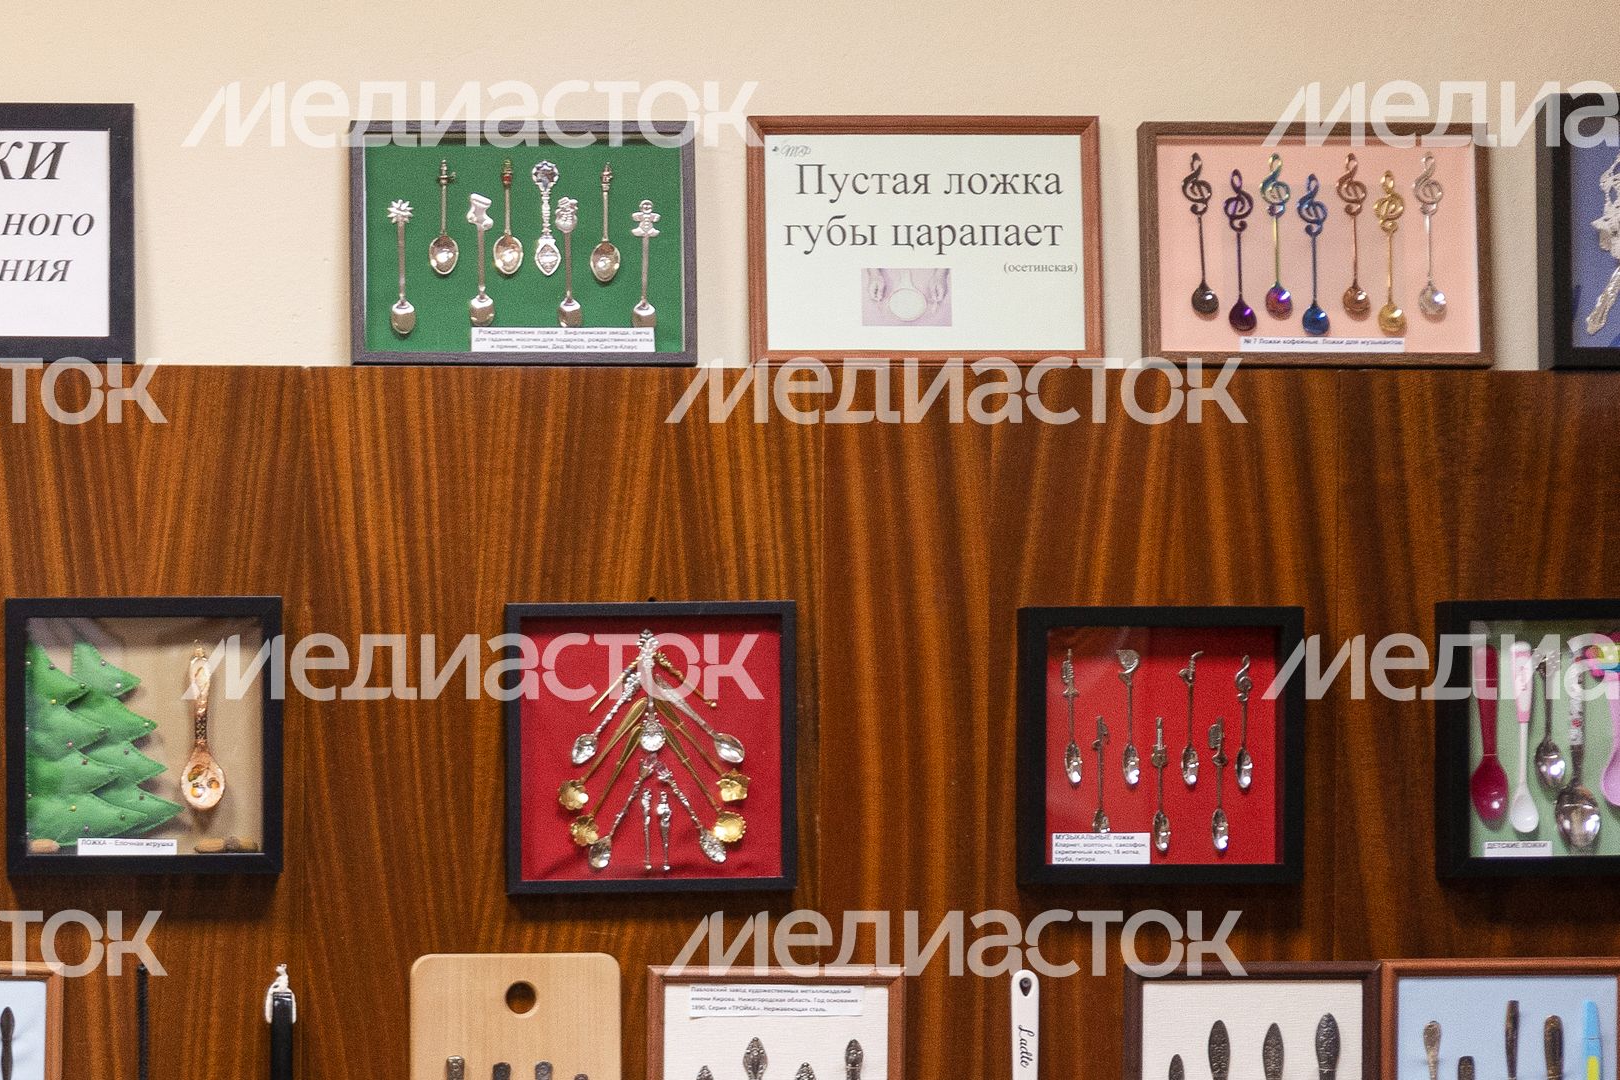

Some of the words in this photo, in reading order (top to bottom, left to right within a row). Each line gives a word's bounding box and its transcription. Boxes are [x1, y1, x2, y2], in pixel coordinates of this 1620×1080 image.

[796, 164, 931, 204] Пустая
[944, 173, 1062, 194] ложка
[784, 215, 878, 255] губы
[892, 225, 1064, 256] царапает
[1004, 264, 1078, 272] (осетинская)
[1018, 1025, 1035, 1068] Ladle
